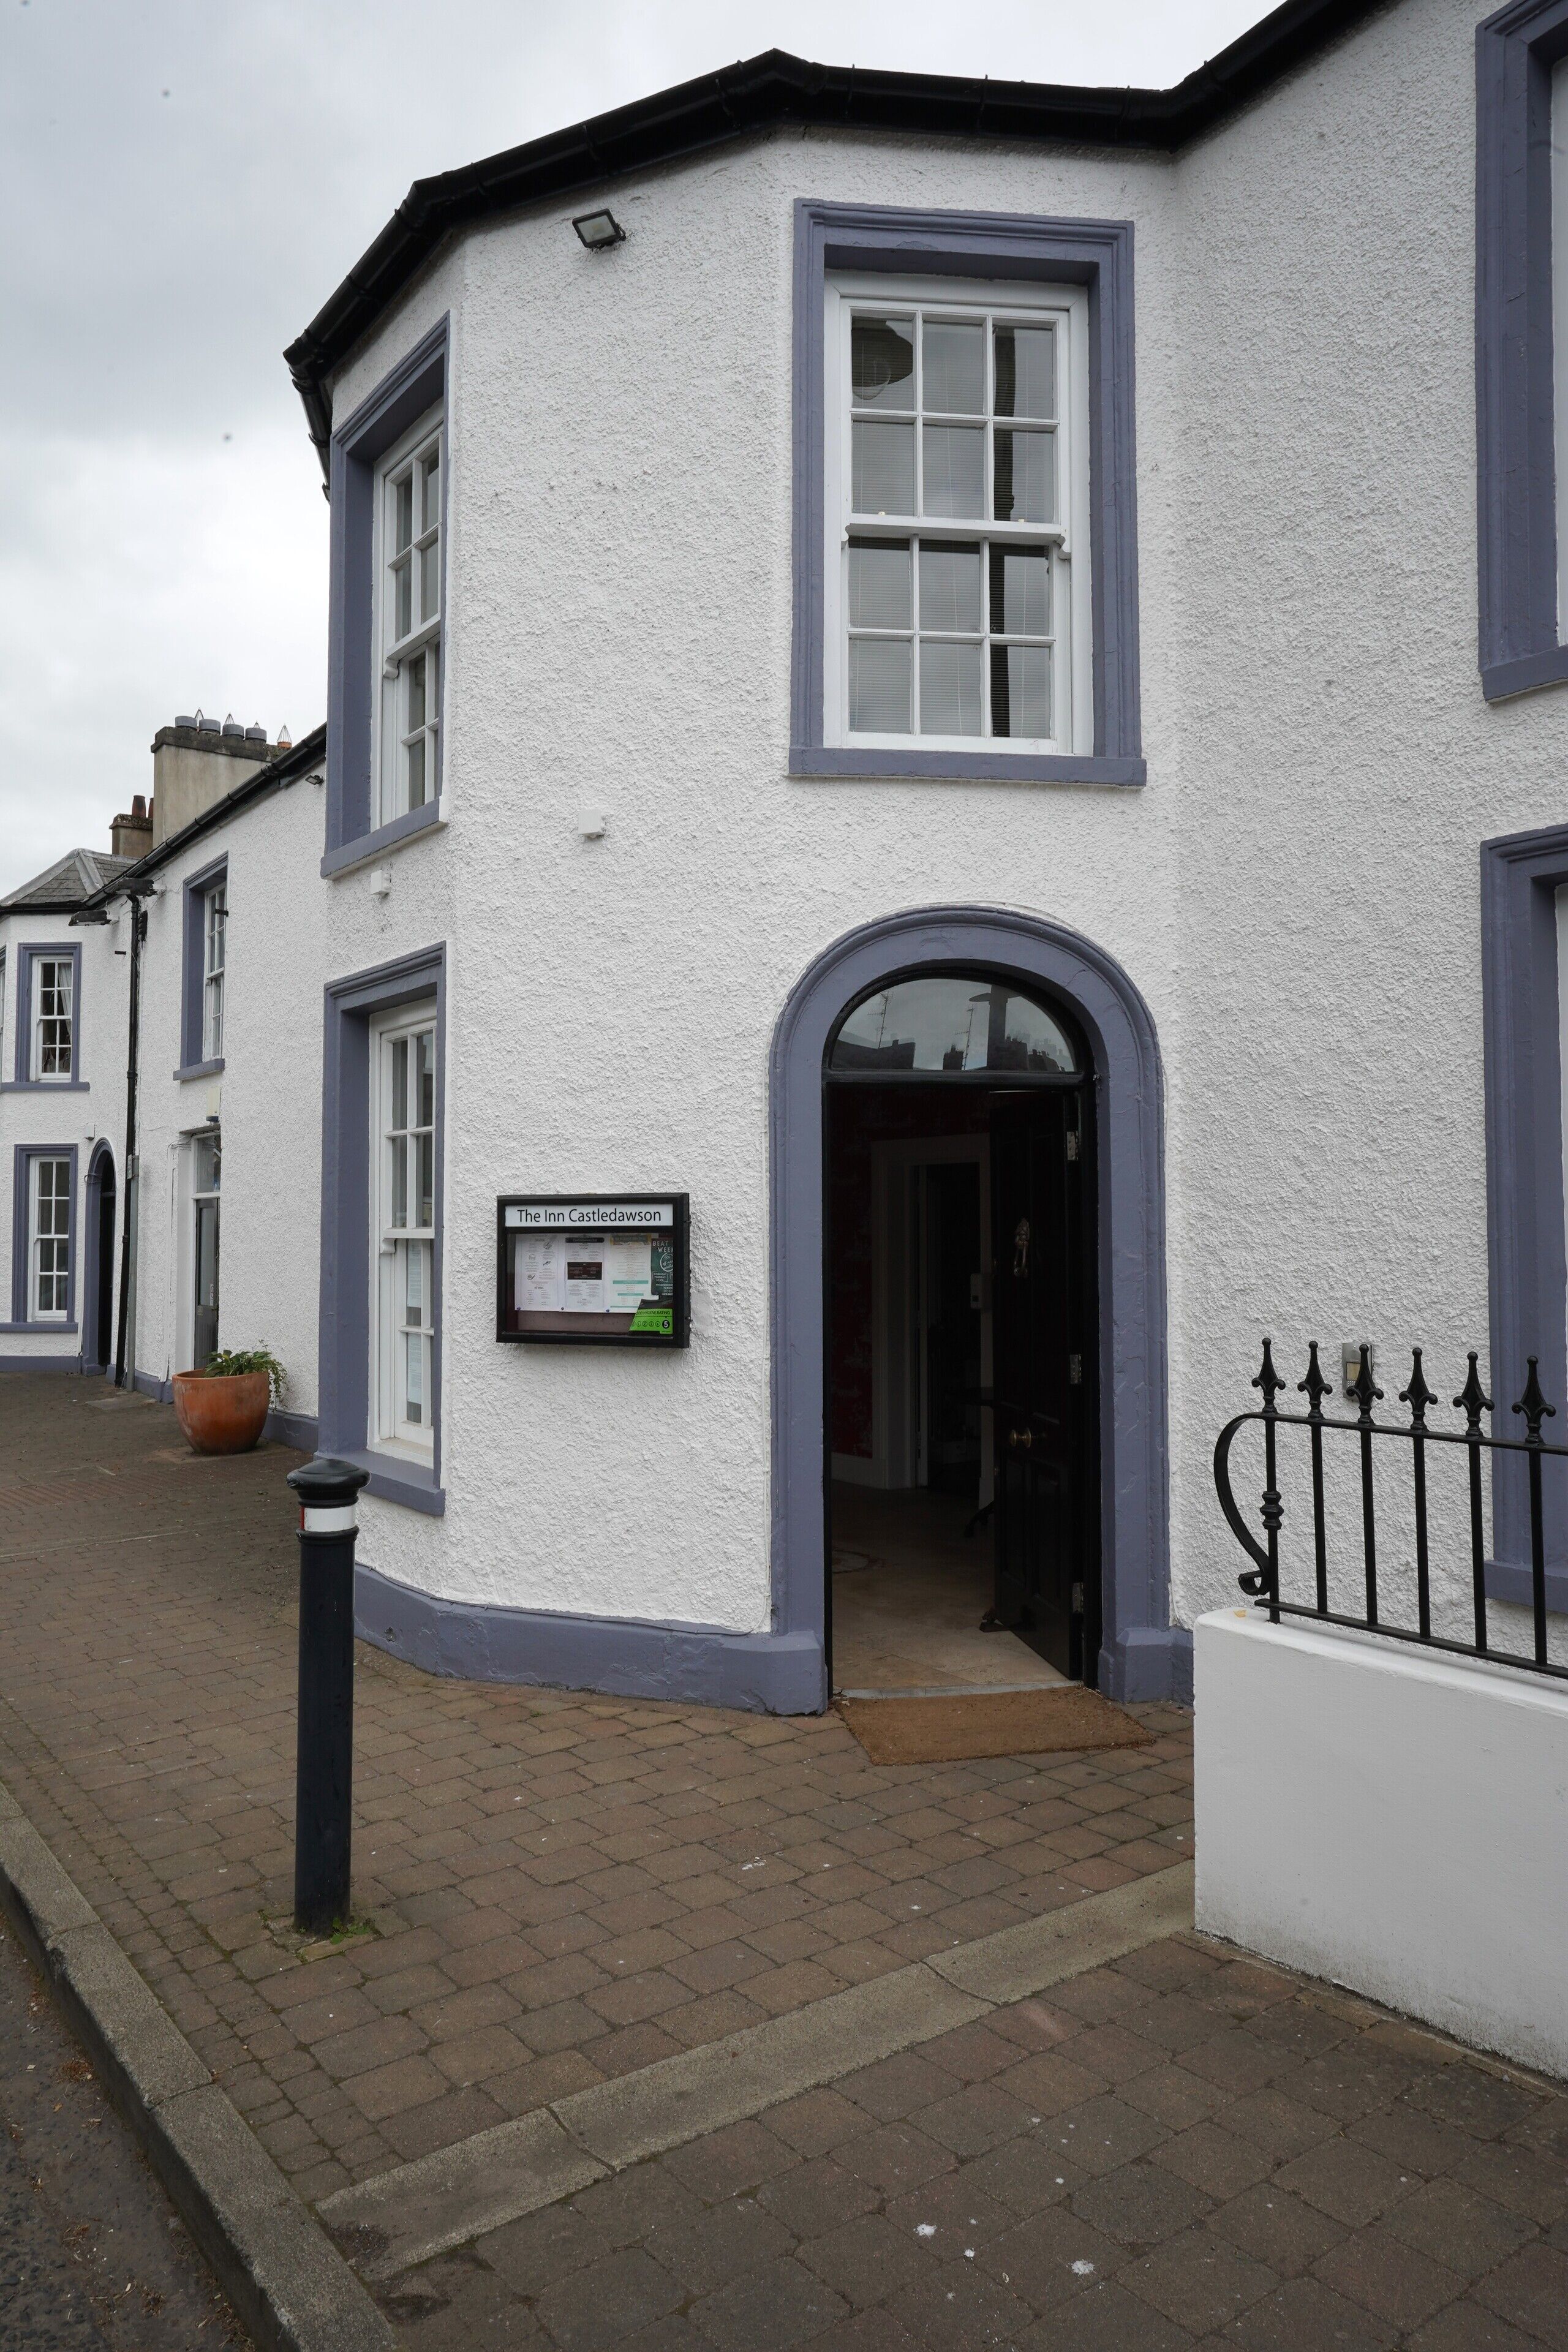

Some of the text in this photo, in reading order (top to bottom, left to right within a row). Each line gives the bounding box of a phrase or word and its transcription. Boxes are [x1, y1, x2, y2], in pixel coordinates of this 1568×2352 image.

[517, 1208, 661, 1222] The Inn Castledawson
